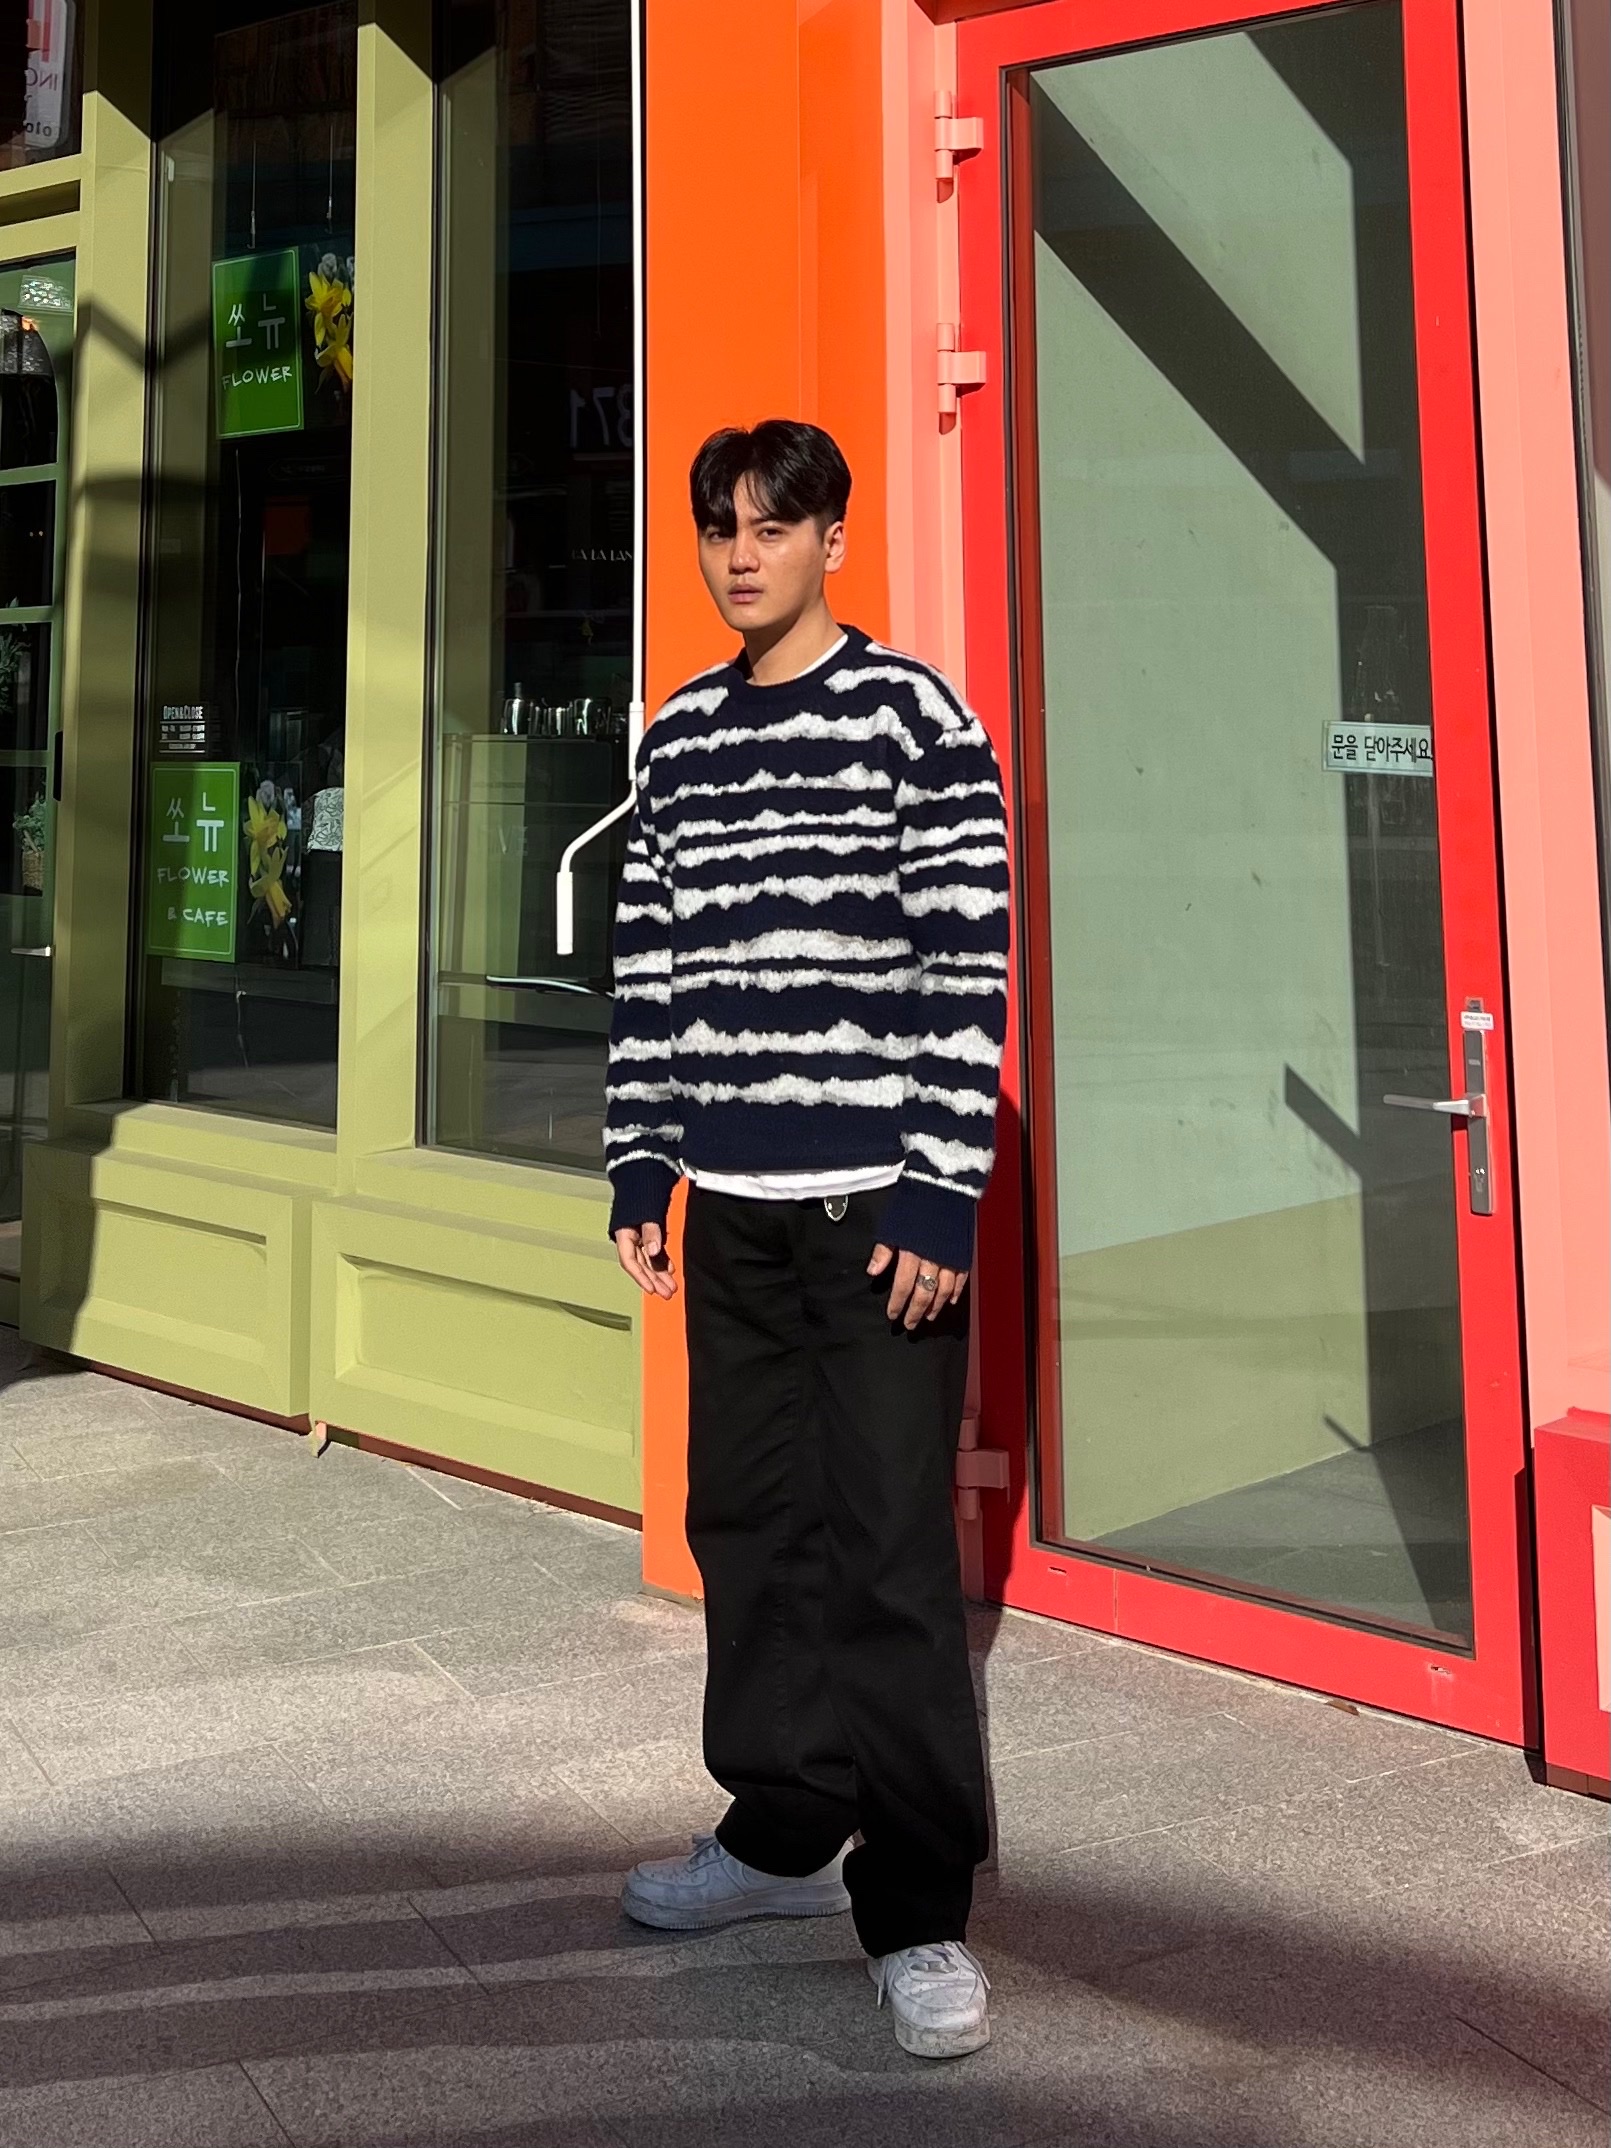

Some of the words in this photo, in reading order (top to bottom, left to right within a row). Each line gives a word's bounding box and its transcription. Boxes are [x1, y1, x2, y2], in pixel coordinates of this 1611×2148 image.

[222, 366, 292, 390] FLOWER
[1331, 734, 1359, 761] 문을
[157, 866, 230, 887] FLOWER
[182, 907, 229, 928] CAFE
